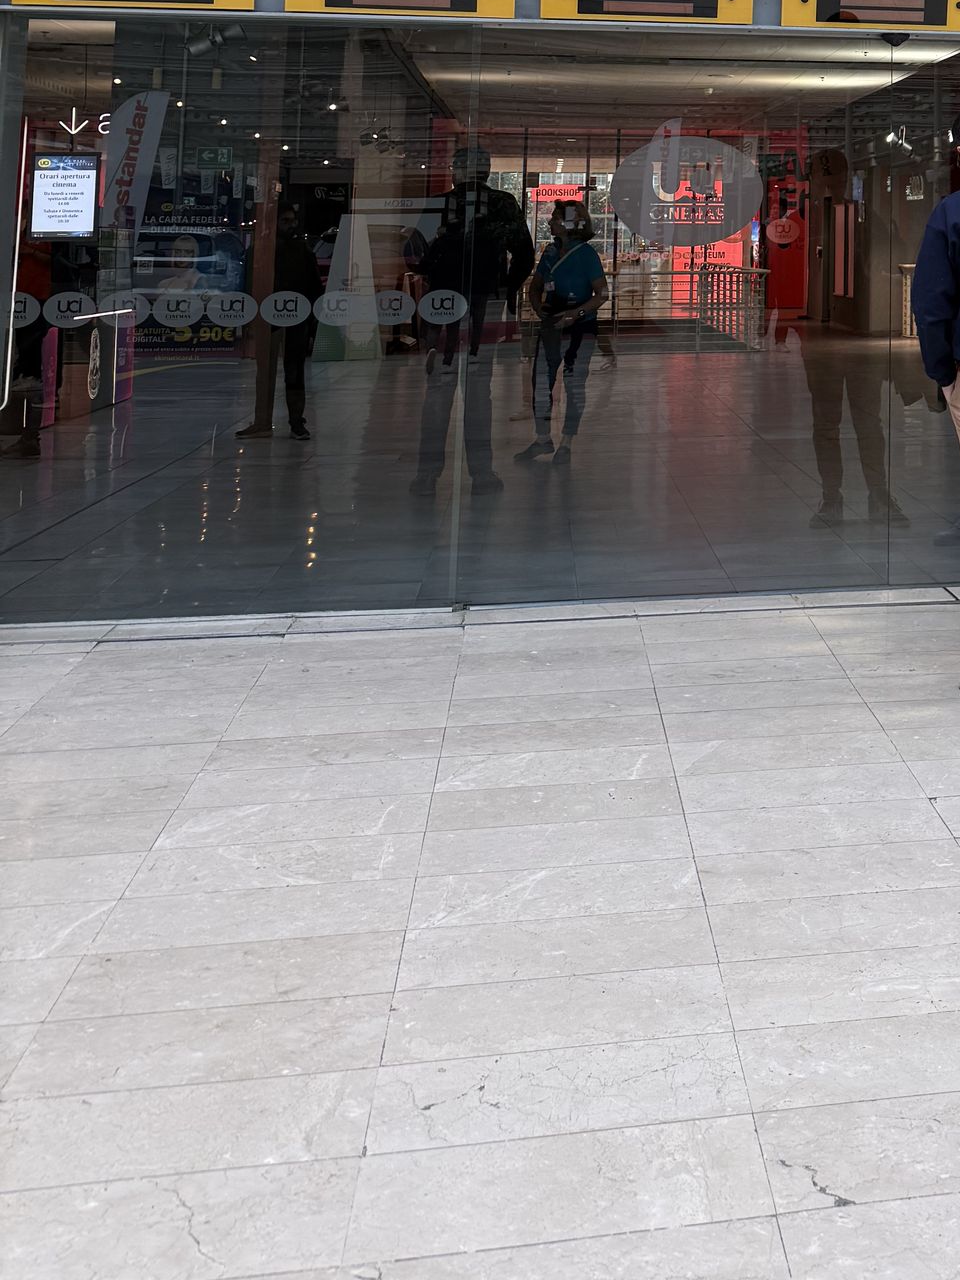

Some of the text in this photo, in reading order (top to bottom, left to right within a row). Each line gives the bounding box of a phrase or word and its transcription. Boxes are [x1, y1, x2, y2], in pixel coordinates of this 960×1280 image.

[60, 173, 91, 181] apertura
[145, 215, 156, 223] LA
[158, 215, 189, 224] CARTA
